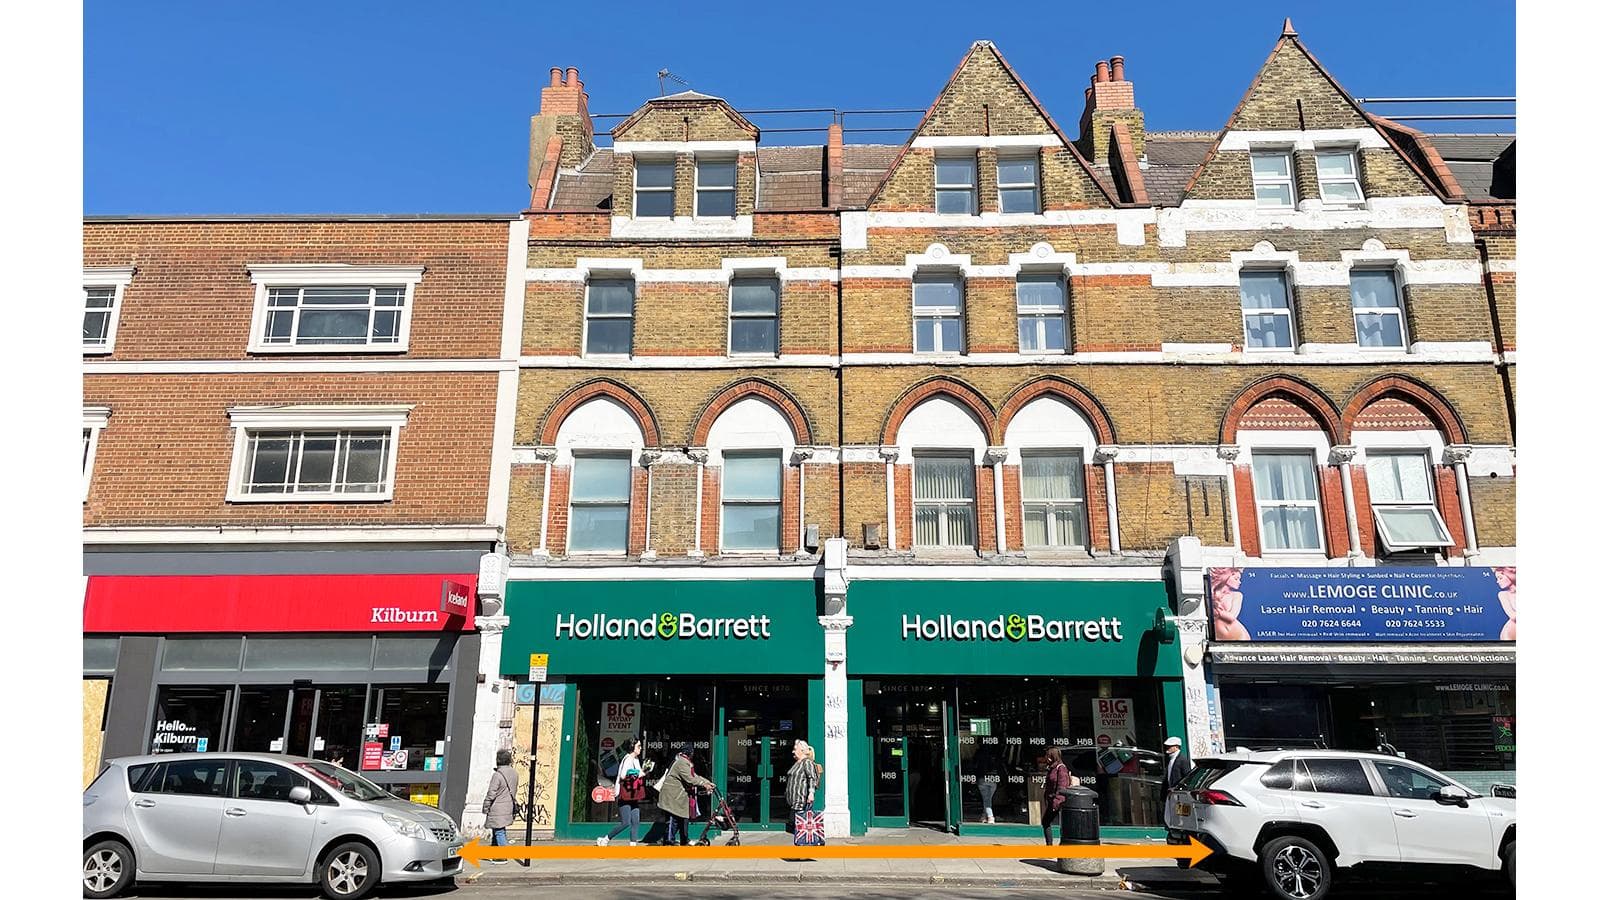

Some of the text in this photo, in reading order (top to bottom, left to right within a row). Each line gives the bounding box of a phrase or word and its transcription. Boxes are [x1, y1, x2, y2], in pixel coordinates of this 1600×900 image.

[1296, 572, 1322, 580] Massage
[1283, 584, 1377, 599] www.LEMOGE
[447, 590, 468, 608] Iceland
[370, 607, 438, 623] Kilburn
[1261, 605, 1484, 616] Laser Hair Removal Beauty Tanning Hair
[1301, 620, 1361, 628] 020 7624 6644
[1385, 620, 1446, 628] 020 7624 5533
[1280, 654, 1296, 662] Hair
[1298, 654, 1332, 662] Removal
[1338, 654, 1366, 663] Beauty
[1395, 654, 1427, 663] Tanning
[1432, 654, 1469, 662] Cosmetic
[1470, 654, 1509, 663] Injections
[607, 703, 636, 717] BIG
[1099, 699, 1128, 714] BIG
[154, 732, 197, 744] Kilburn
